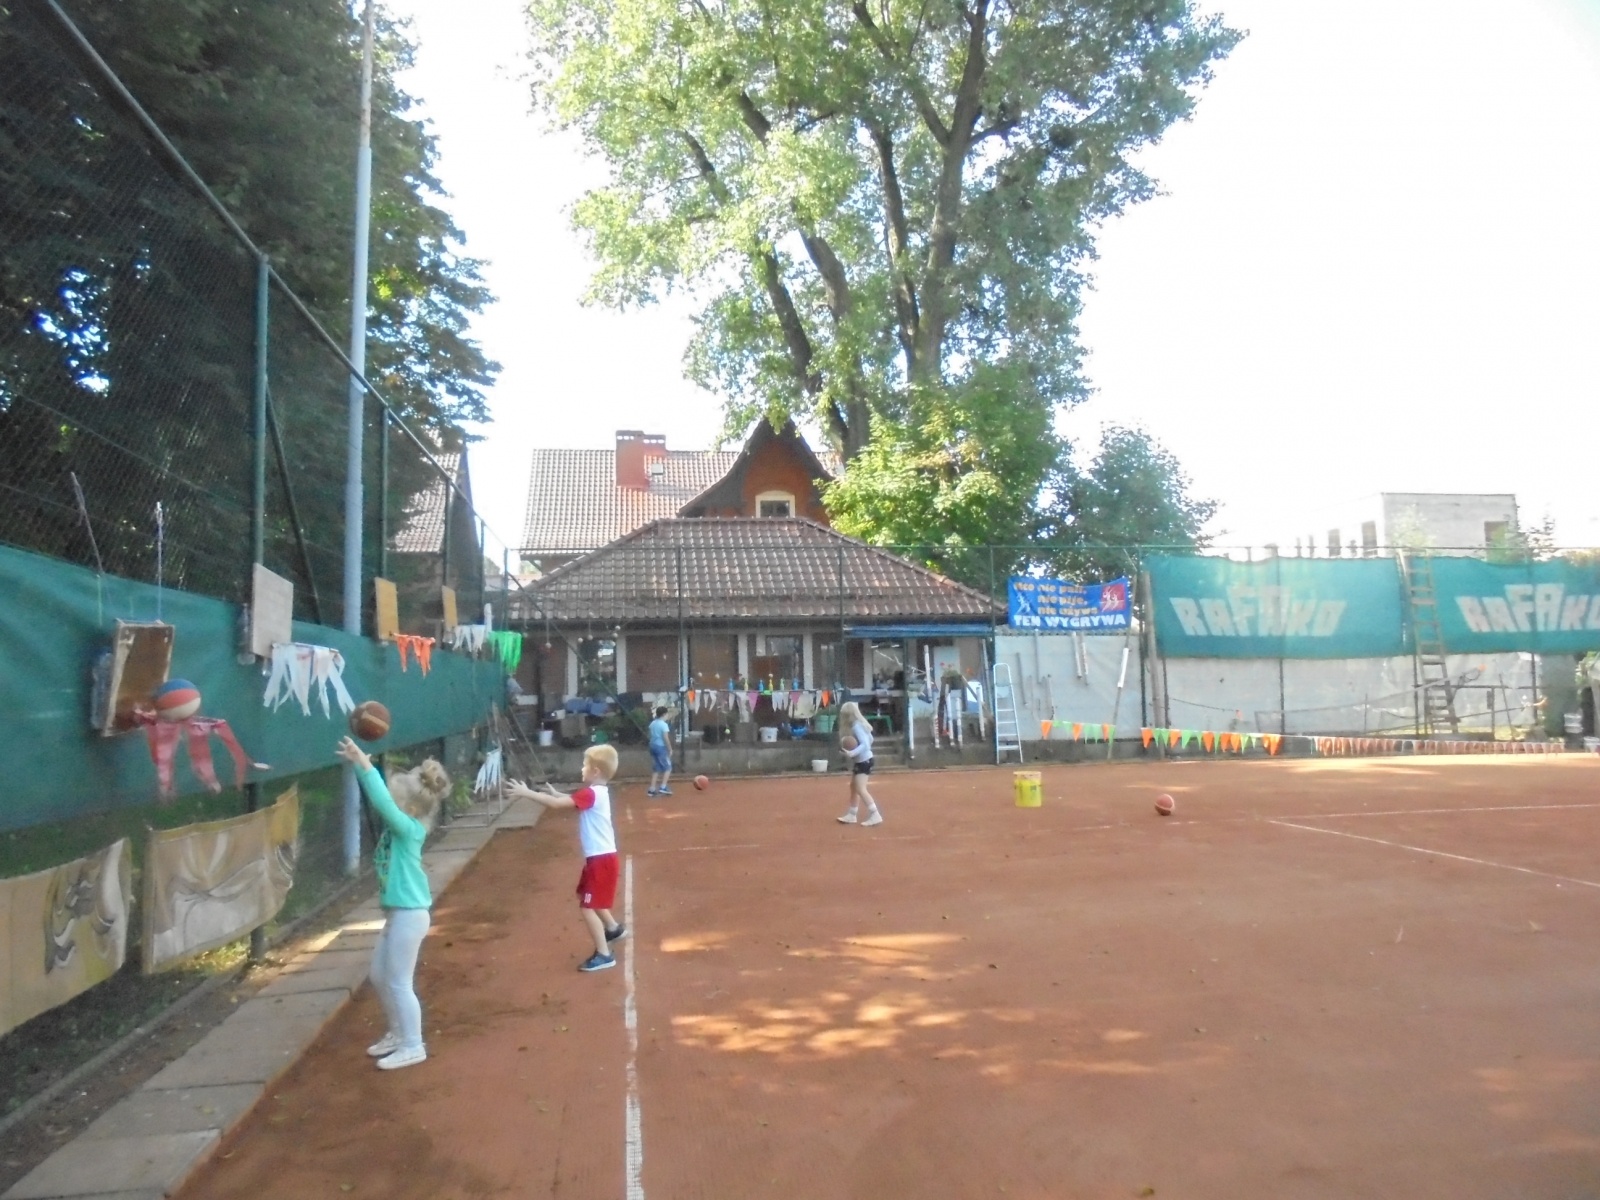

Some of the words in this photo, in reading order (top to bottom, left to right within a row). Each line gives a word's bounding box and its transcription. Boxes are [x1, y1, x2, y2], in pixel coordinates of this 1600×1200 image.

[1037, 583, 1056, 593] nie
[1038, 594, 1057, 604] nie
[1038, 605, 1057, 615] nie
[1169, 582, 1348, 637] RAFAKO
[1013, 615, 1041, 627] TEN
[1044, 614, 1126, 628] WYGRYWA
